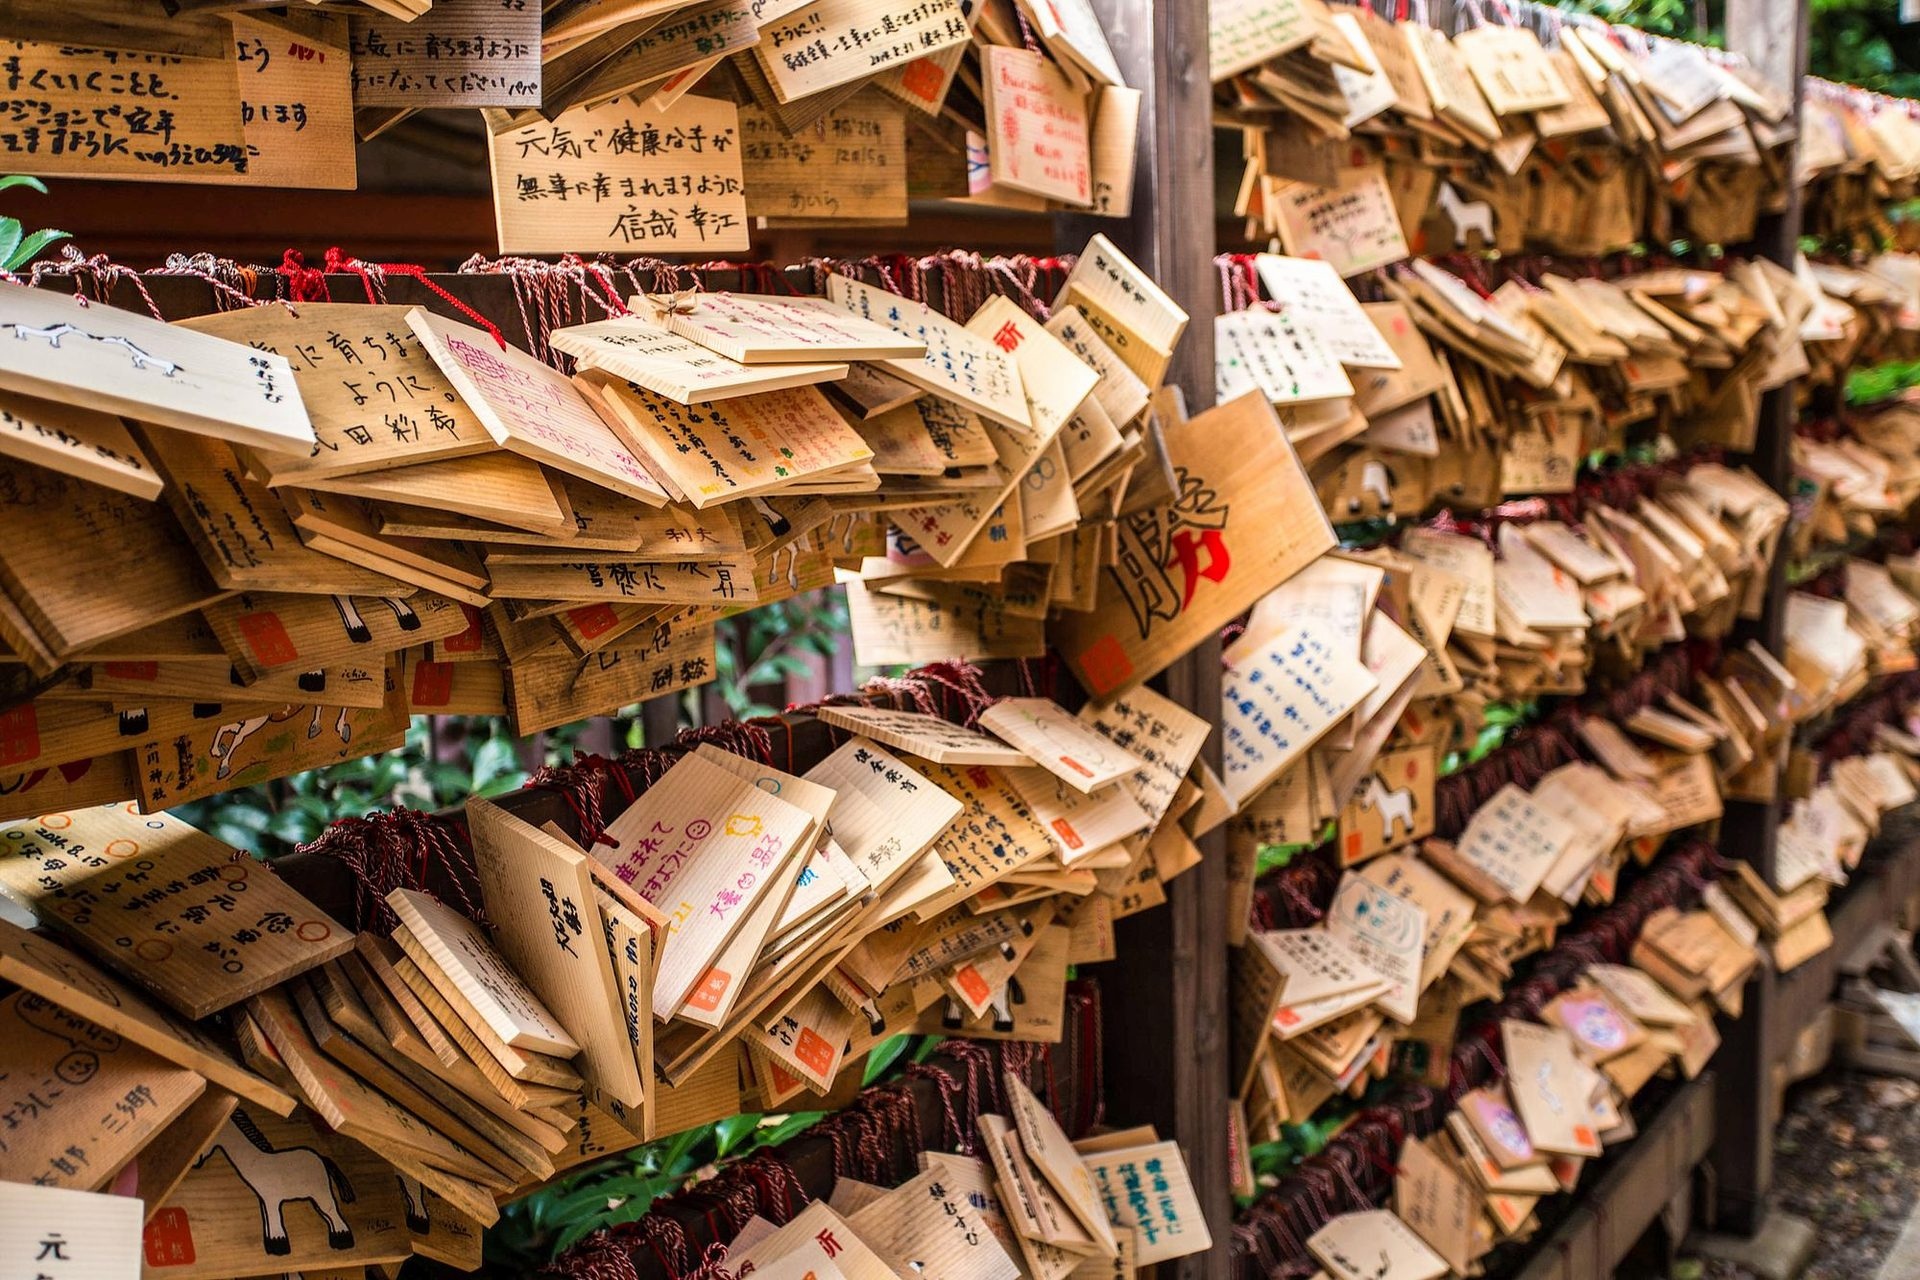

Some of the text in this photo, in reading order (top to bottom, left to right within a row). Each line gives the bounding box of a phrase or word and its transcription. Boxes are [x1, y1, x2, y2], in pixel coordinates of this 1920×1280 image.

[516, 119, 734, 161] 元気で健康な子が
[516, 172, 745, 202] 無事に産まれますように。
[614, 820, 674, 886] 産まれて
[34, 1232, 71, 1262] 元
